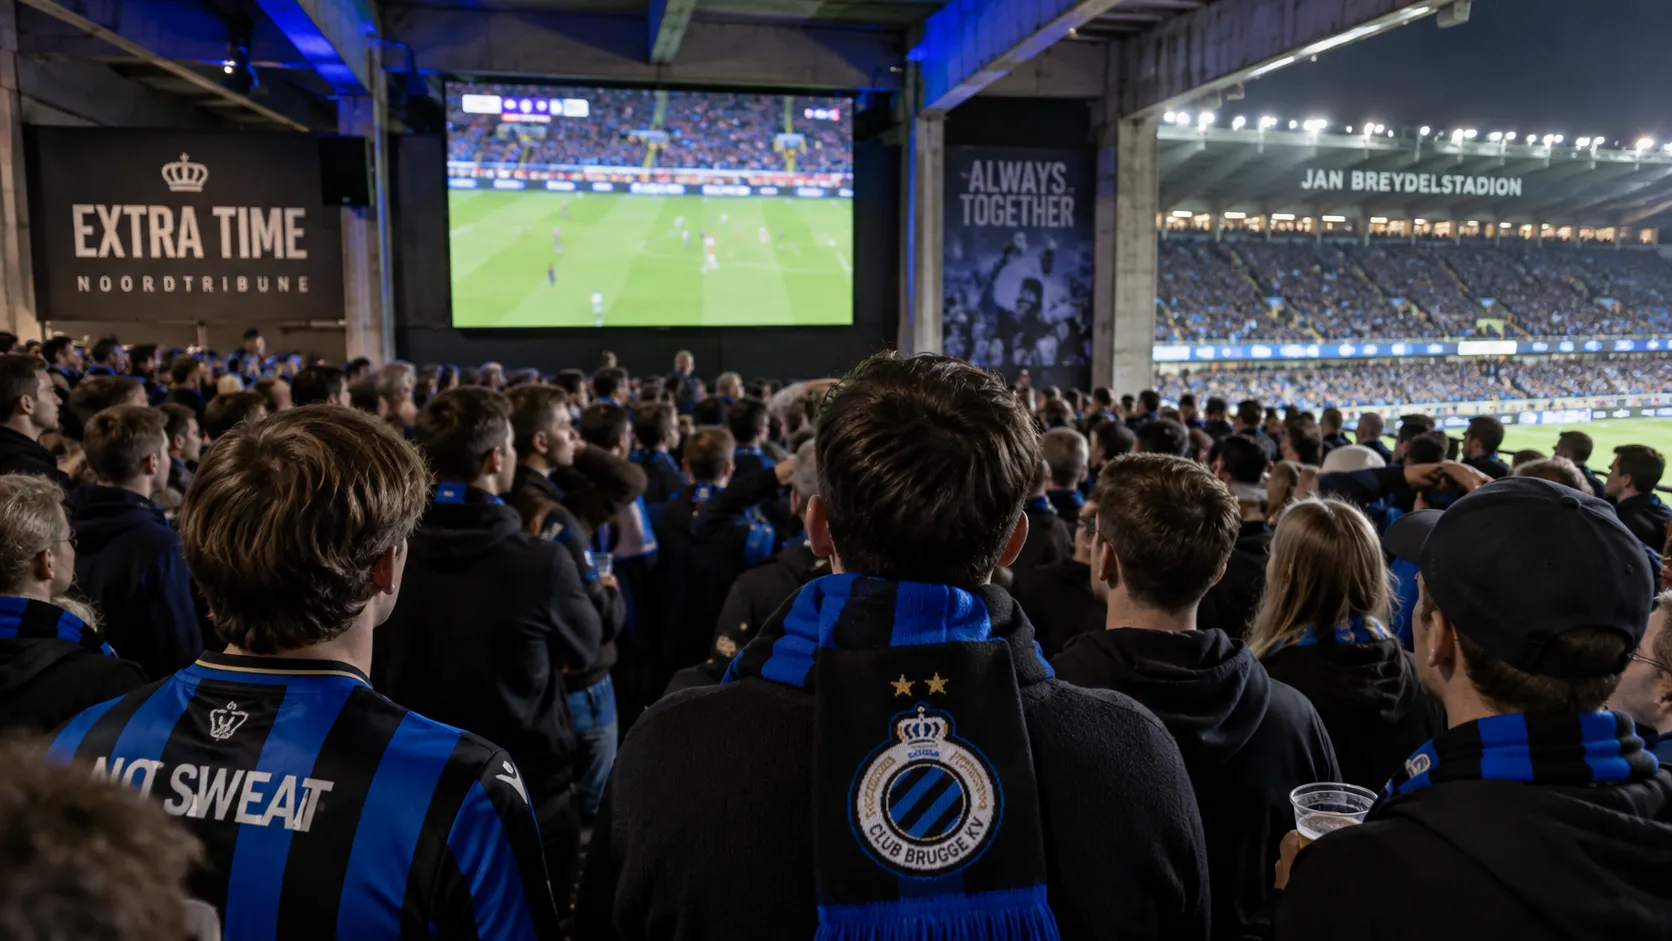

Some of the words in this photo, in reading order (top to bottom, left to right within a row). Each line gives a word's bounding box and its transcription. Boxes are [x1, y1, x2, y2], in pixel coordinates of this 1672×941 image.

[968, 160, 1068, 195] ALWAYS
[1301, 168, 1344, 190] JAN
[1351, 170, 1523, 197] BREYDELSTADION
[960, 193, 1075, 228] TOGETHER
[72, 204, 204, 259] EXTRA
[212, 206, 308, 260] TIME
[77, 275, 309, 293] NOORDTRIBUNE
[163, 763, 335, 833] SWEAT
[869, 823, 903, 857] CLUB
[904, 836, 969, 866] BRUGGE
[964, 815, 985, 840] KV
